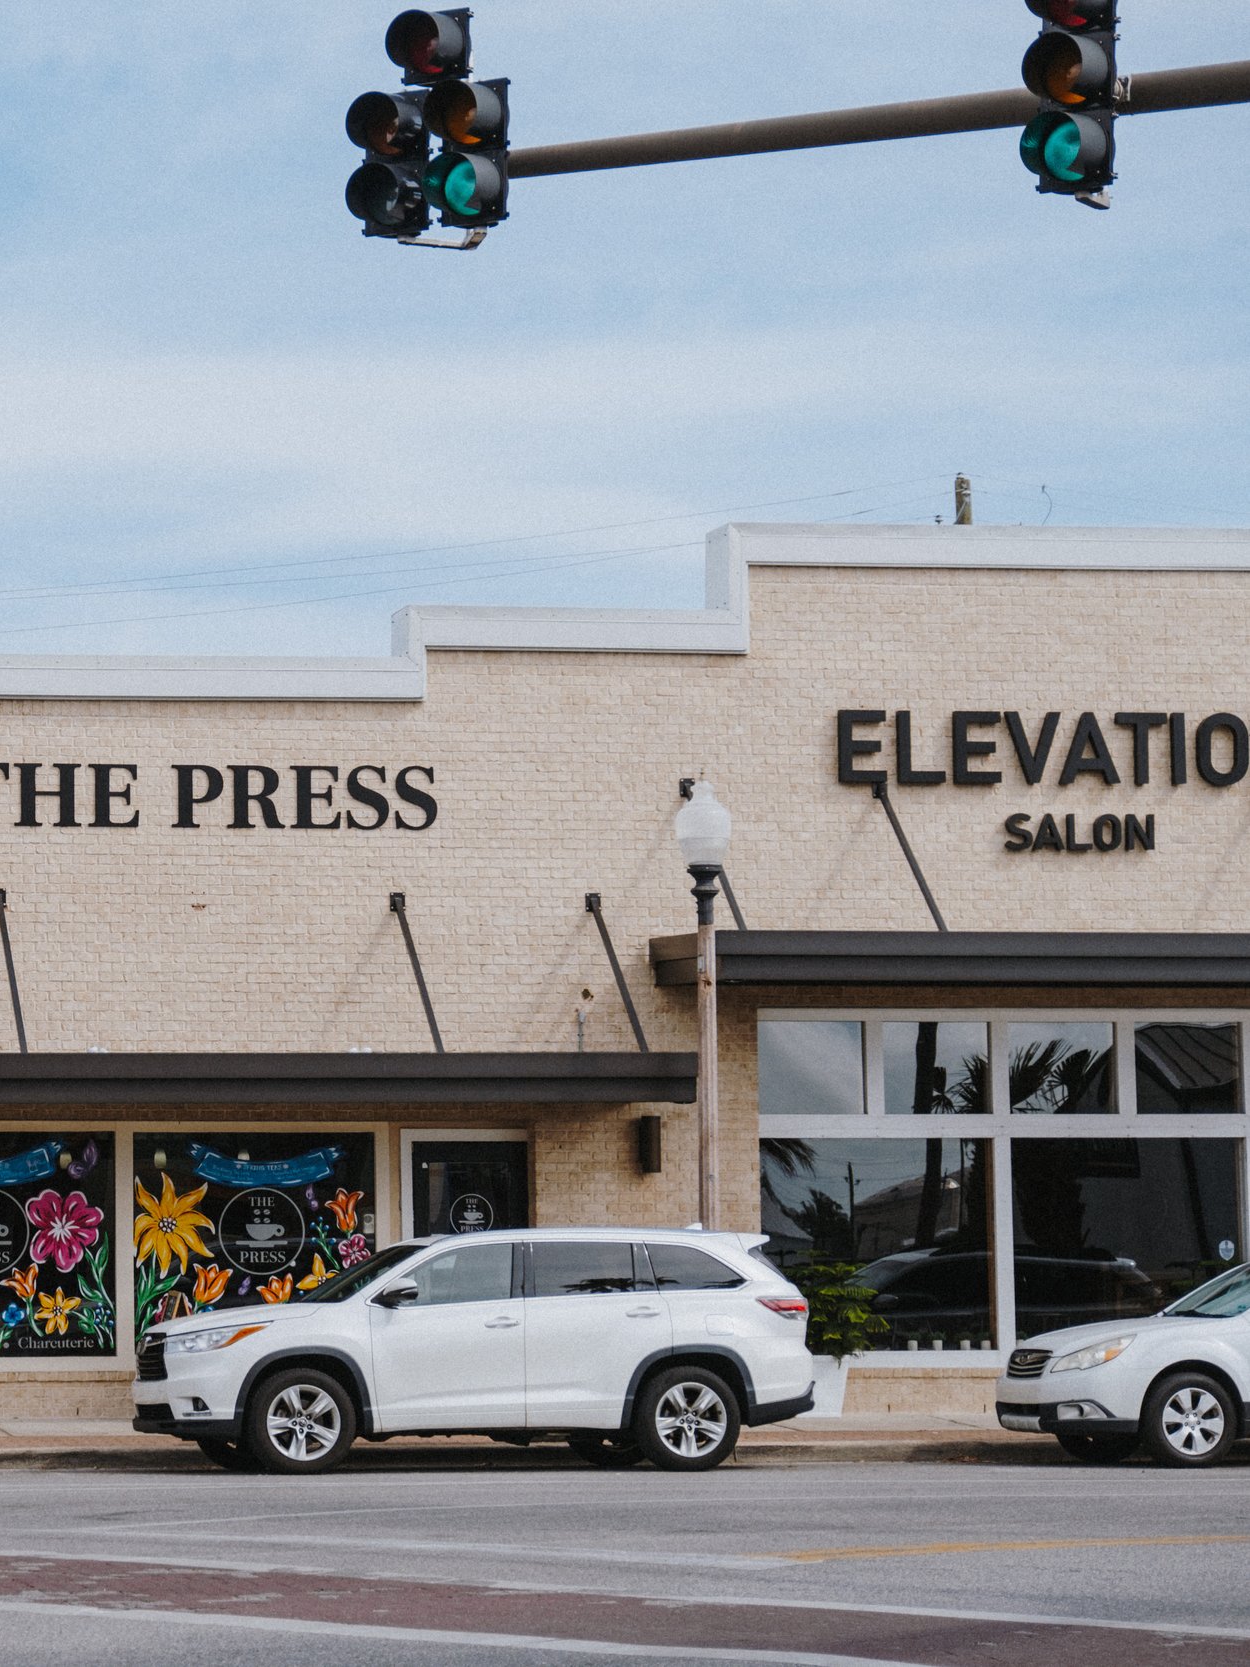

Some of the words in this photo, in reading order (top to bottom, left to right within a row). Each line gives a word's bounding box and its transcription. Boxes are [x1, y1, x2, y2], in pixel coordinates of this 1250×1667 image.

[836, 708, 1250, 788] ELEVATIO
[171, 763, 439, 832] PRESS
[1003, 812, 1156, 853] SALON
[248, 1196, 275, 1207] THE
[240, 1250, 286, 1264] PRESS
[17, 1336, 94, 1350] Charcuterie
